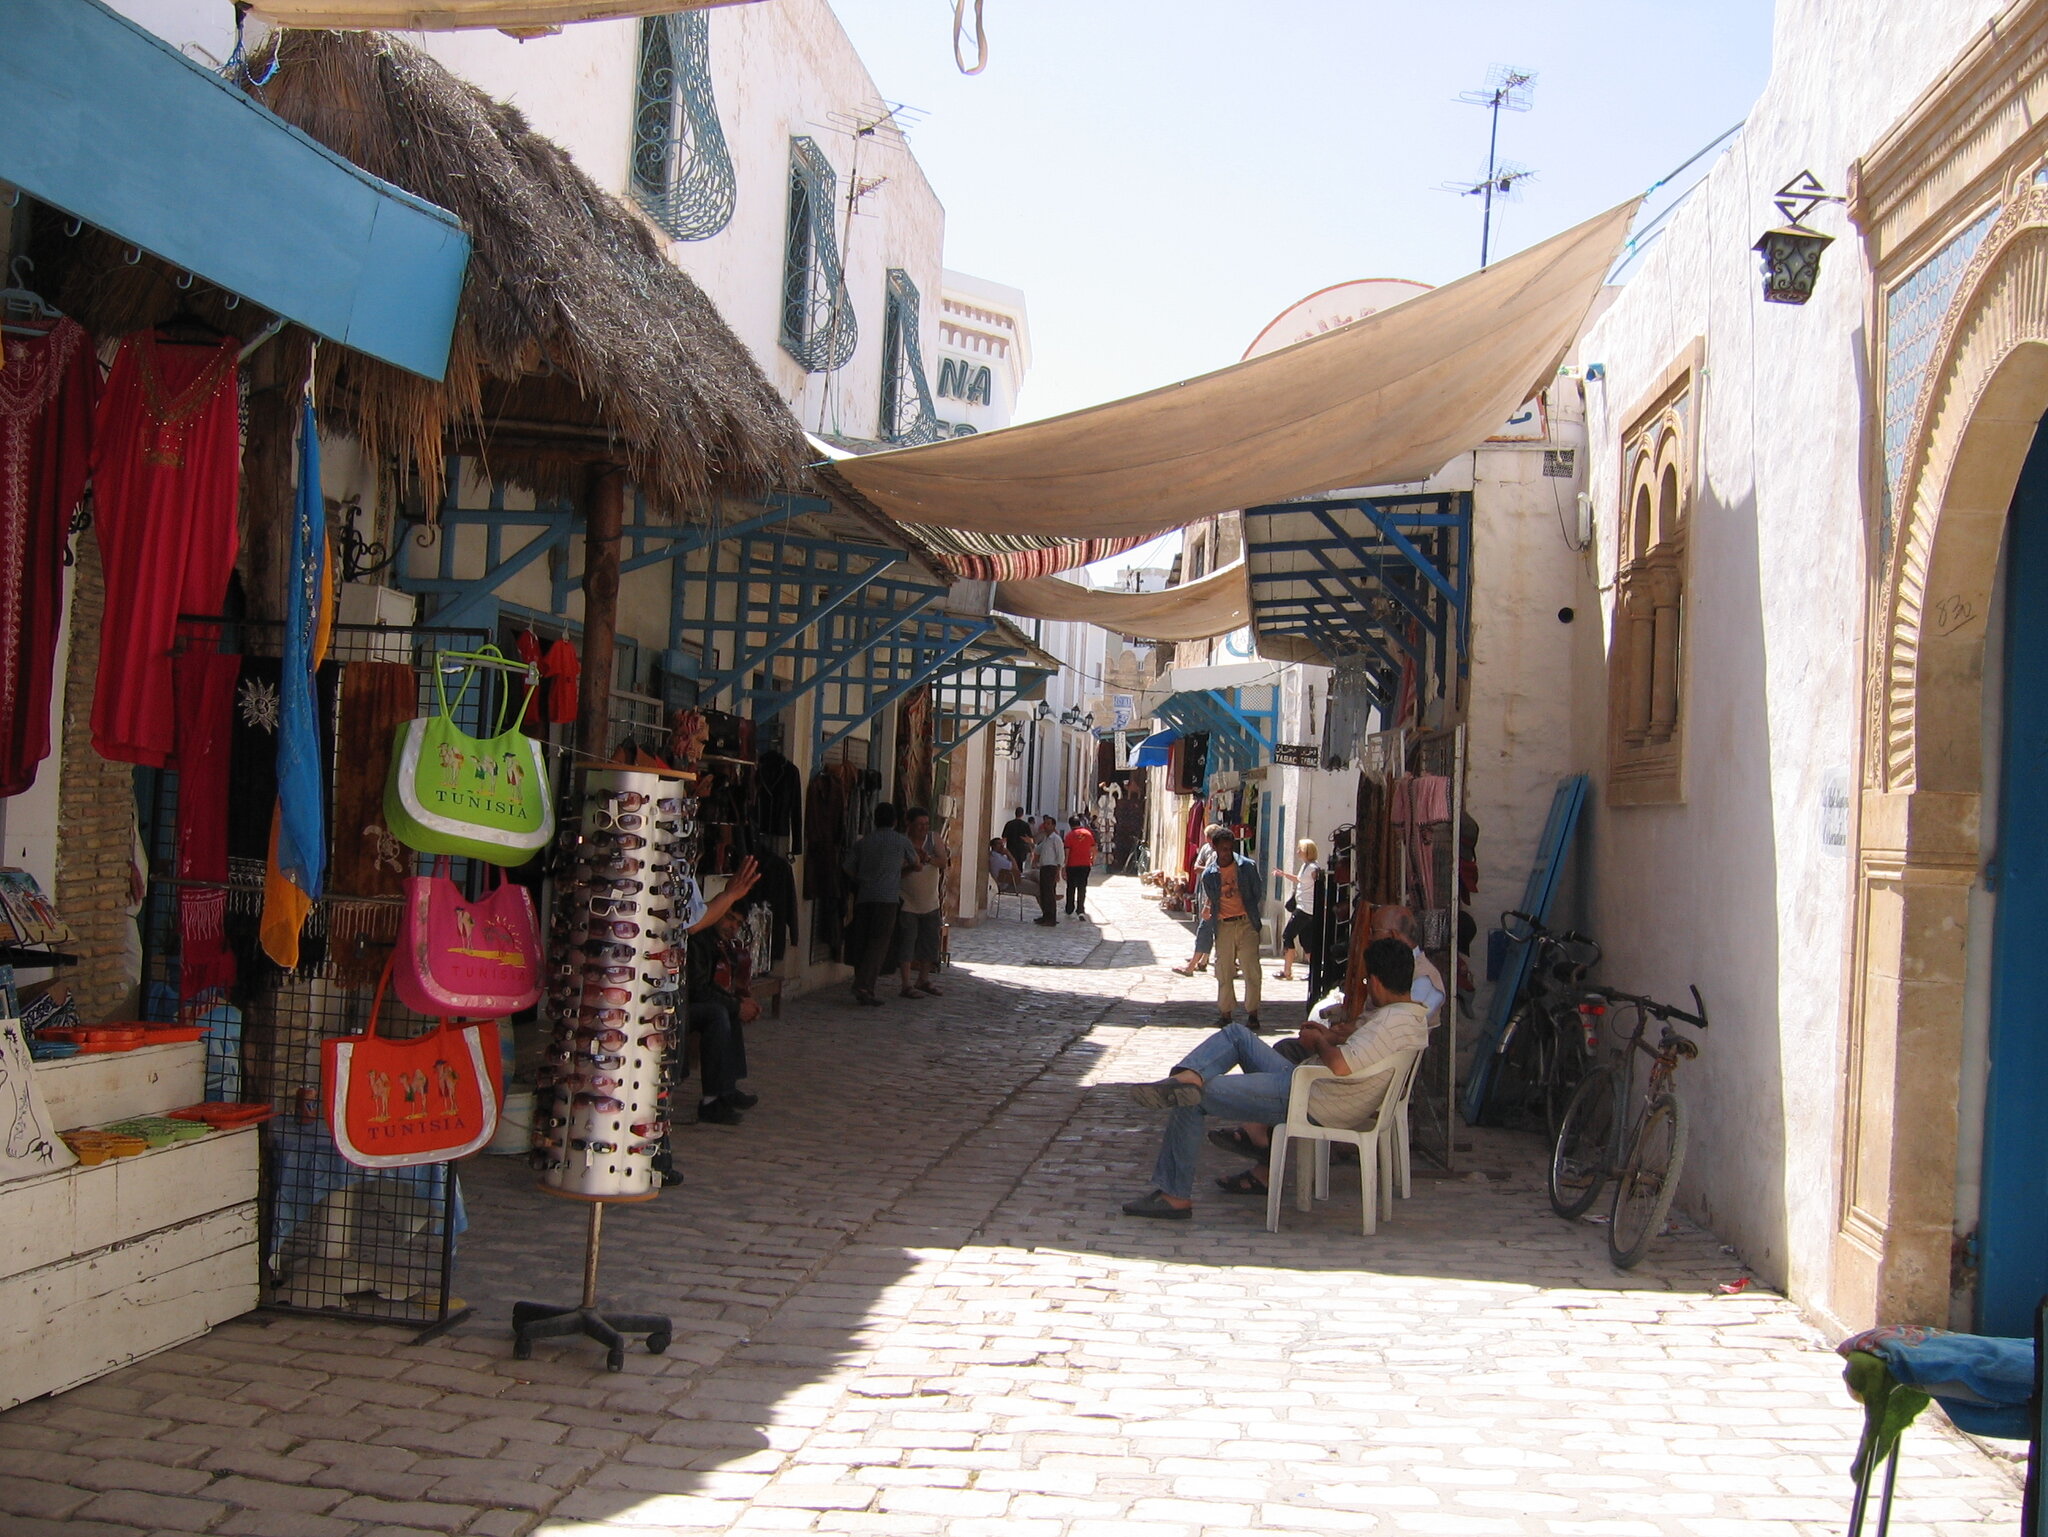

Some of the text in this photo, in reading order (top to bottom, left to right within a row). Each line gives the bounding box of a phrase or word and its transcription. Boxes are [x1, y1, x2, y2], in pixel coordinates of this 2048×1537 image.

[1275, 754, 1298, 766] TABAC
[435, 789, 528, 820] TUNISIA
[452, 965, 527, 981] TUNISIA
[367, 1117, 465, 1140] TUNISIA
